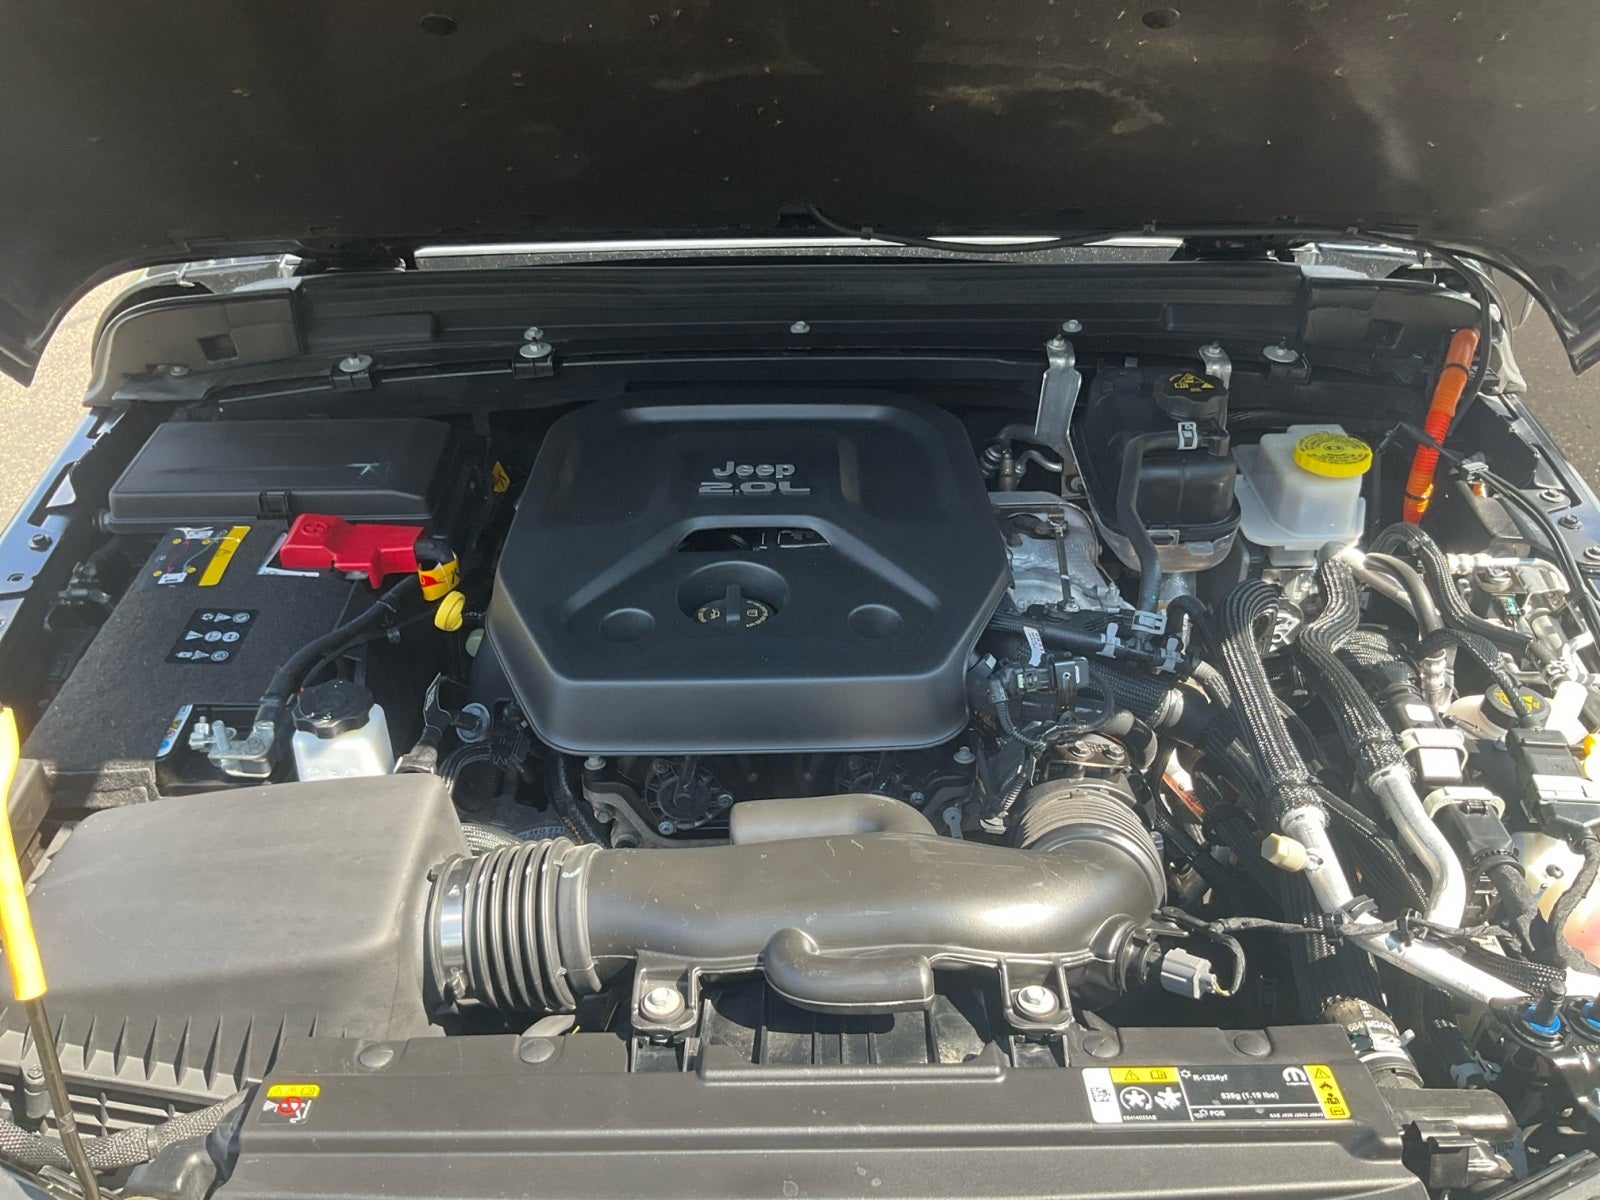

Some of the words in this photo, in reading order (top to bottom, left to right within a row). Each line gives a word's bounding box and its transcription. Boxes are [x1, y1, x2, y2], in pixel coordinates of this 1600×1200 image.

[712, 461, 796, 479] Jeep
[698, 481, 811, 495] 2.0L
[1192, 1074, 1228, 1082] R-1234yf
